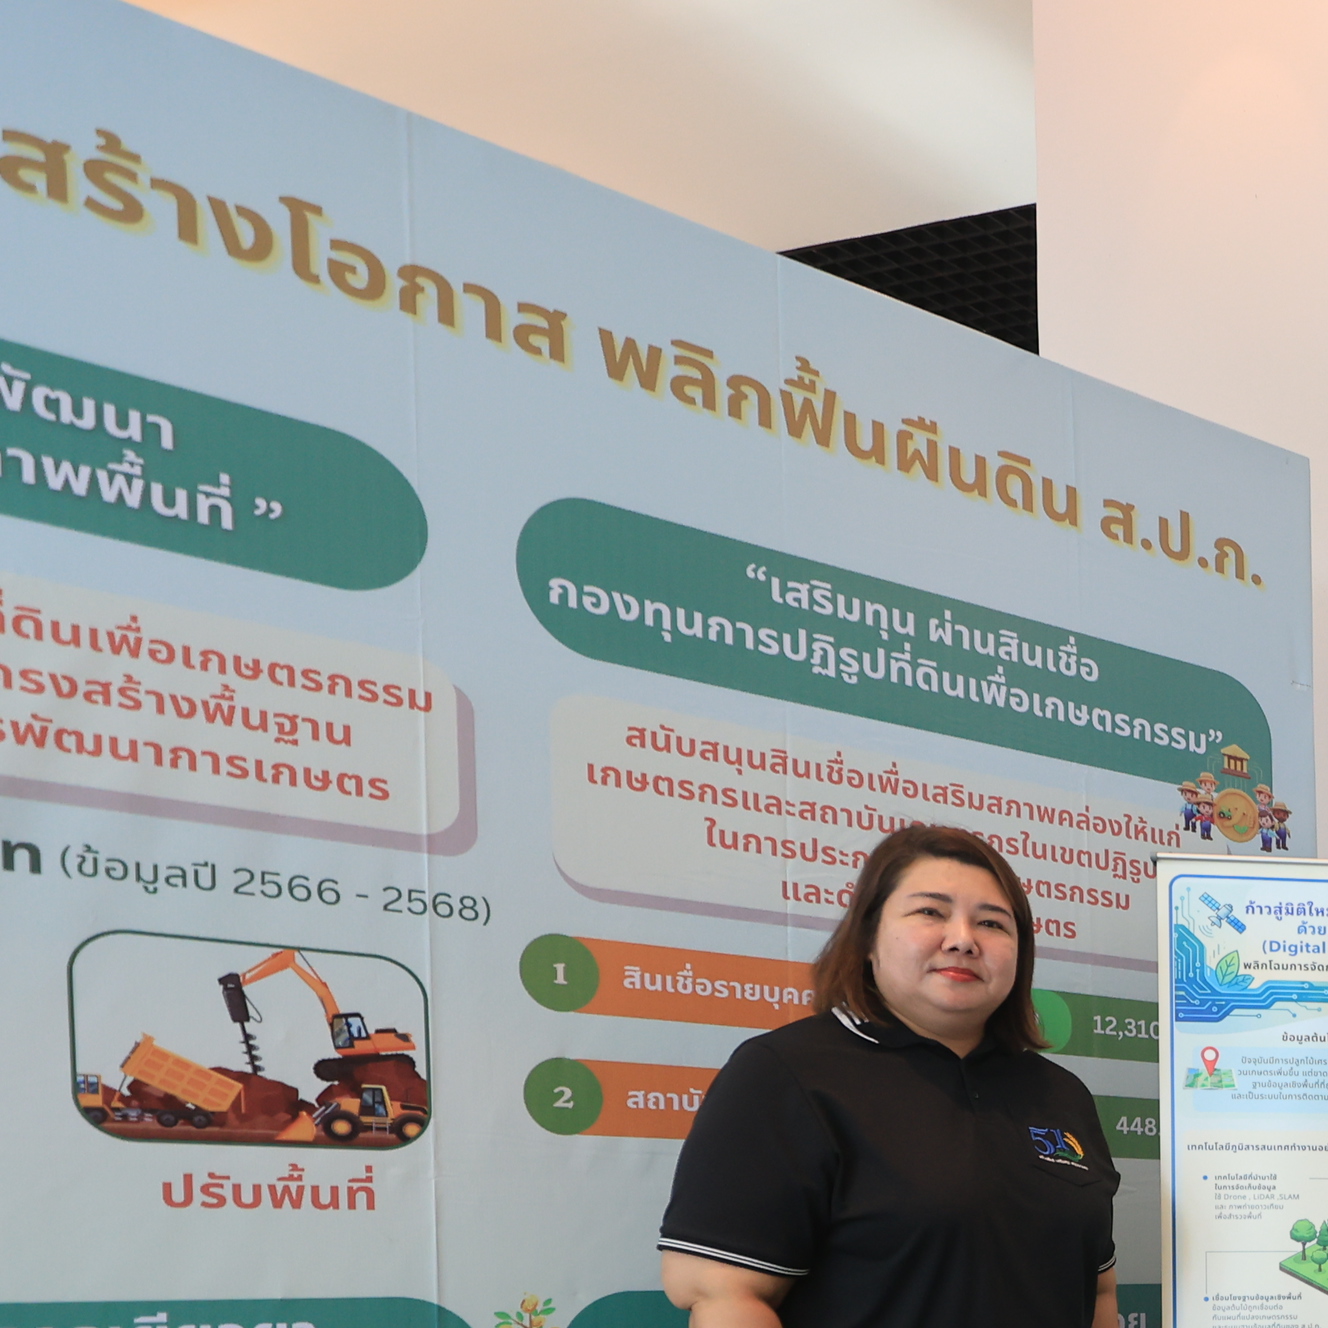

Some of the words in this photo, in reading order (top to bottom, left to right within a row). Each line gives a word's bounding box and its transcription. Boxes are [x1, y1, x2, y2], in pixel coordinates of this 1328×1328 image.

[2, 127, 567, 364] สร้างโอกาส
[598, 325, 1080, 529] พลิกฟื้นผืนดิน
[1099, 497, 1264, 586] ส.ป.ก.
[746, 564, 915, 637] “เสริมทุน
[928, 612, 1100, 683] ผ่านสินเชื่อ
[625, 722, 1182, 850] สนับสนุนสินเชื่อเพื่อเสริมสภาพคล่องให้แก่
[60, 843, 217, 895] (ข้อมูลปี
[232, 867, 341, 905] 2566
[382, 885, 492, 926] 2568)
[552, 963, 569, 986] 1
[1262, 940, 1326, 956] (Digital
[553, 1086, 574, 1109] 2
[162, 1164, 377, 1212] ปรับพื้นที่
